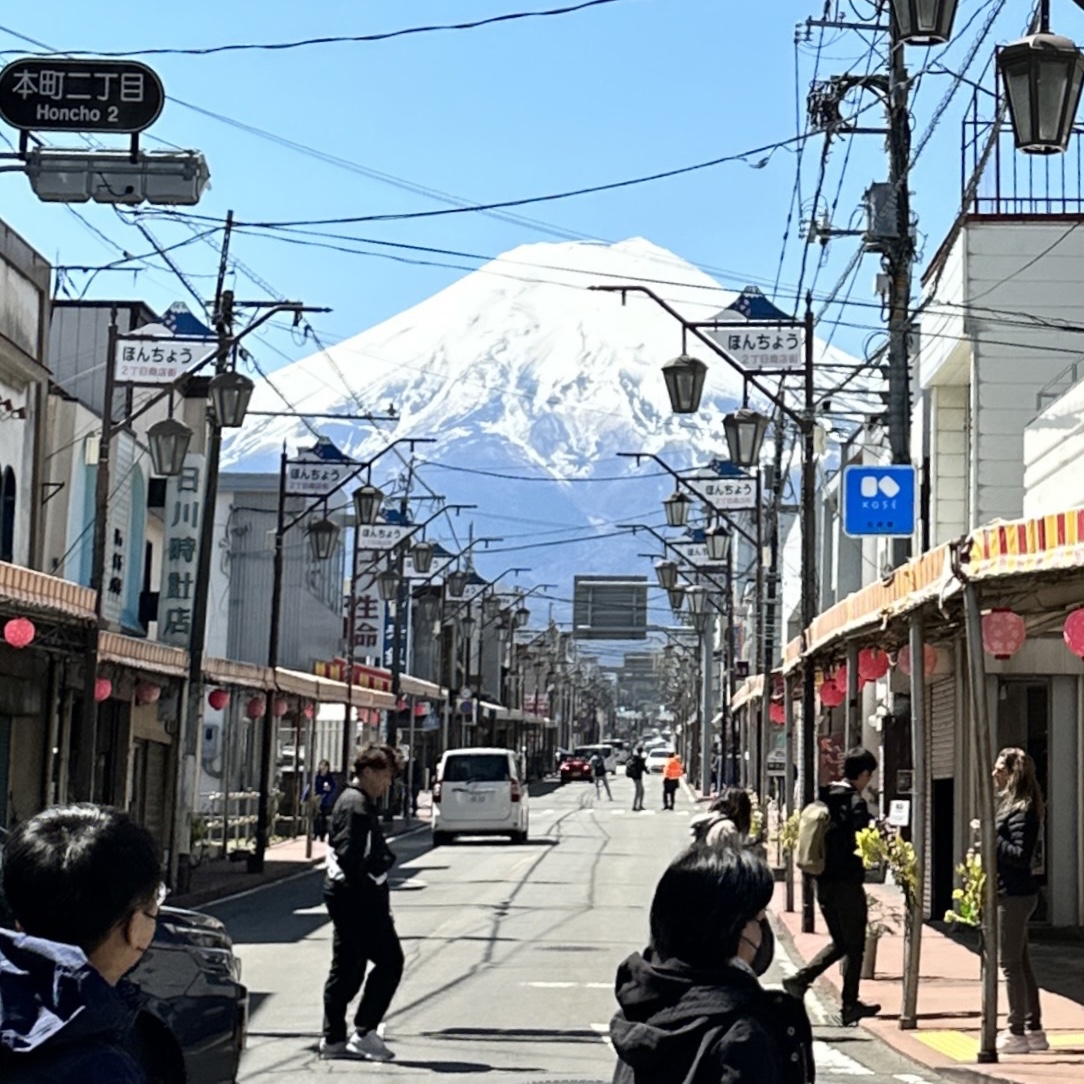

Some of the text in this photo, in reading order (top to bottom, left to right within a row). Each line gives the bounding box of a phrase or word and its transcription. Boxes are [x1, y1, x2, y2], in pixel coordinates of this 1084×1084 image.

[12, 69, 144, 102] 本町二丁目
[36, 104, 119, 122] Honcho 2
[727, 333, 798, 350] ほんちょう
[122, 346, 192, 364] ほんちょう
[290, 468, 339, 481] ほんちょう
